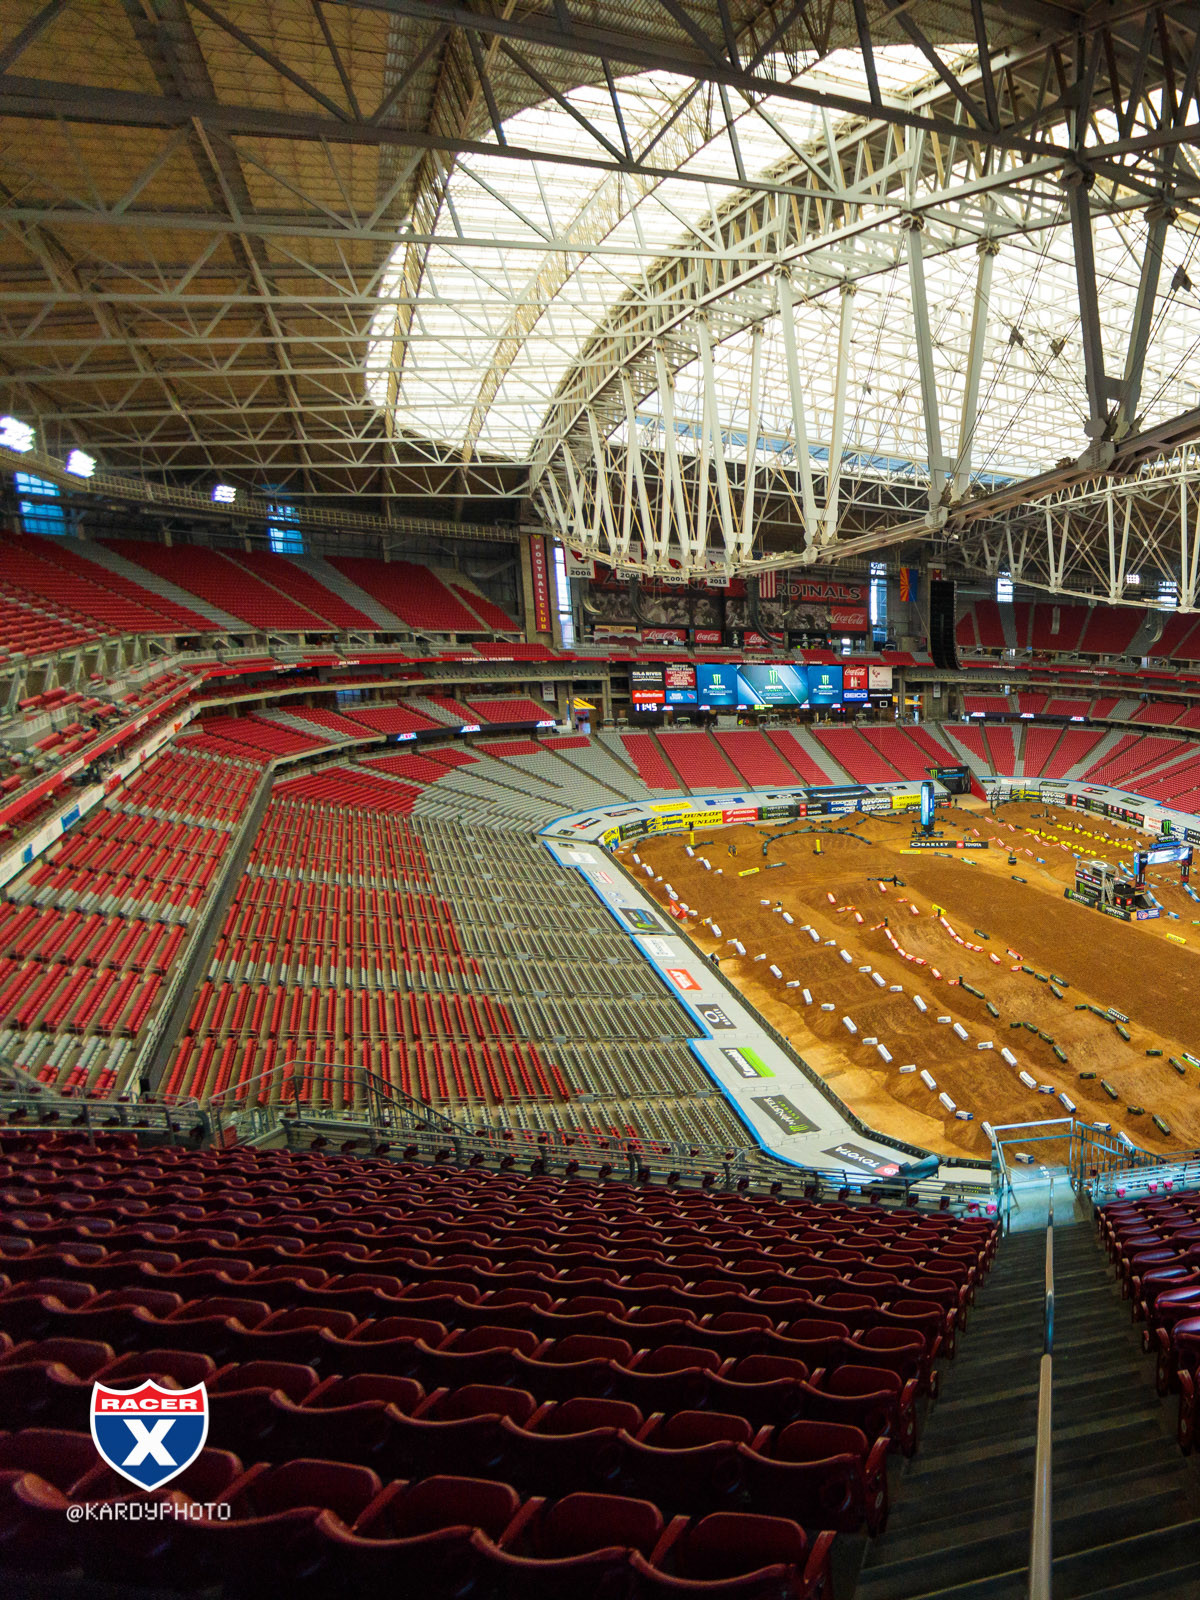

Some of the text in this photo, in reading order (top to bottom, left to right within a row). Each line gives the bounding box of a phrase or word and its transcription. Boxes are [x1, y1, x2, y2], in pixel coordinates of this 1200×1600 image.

[535, 544, 545, 600] FOOTBALL
[696, 632, 719, 641] Coca-Cola
[763, 1097, 797, 1126] MONSTER
[835, 1146, 880, 1168] TOYOTA
